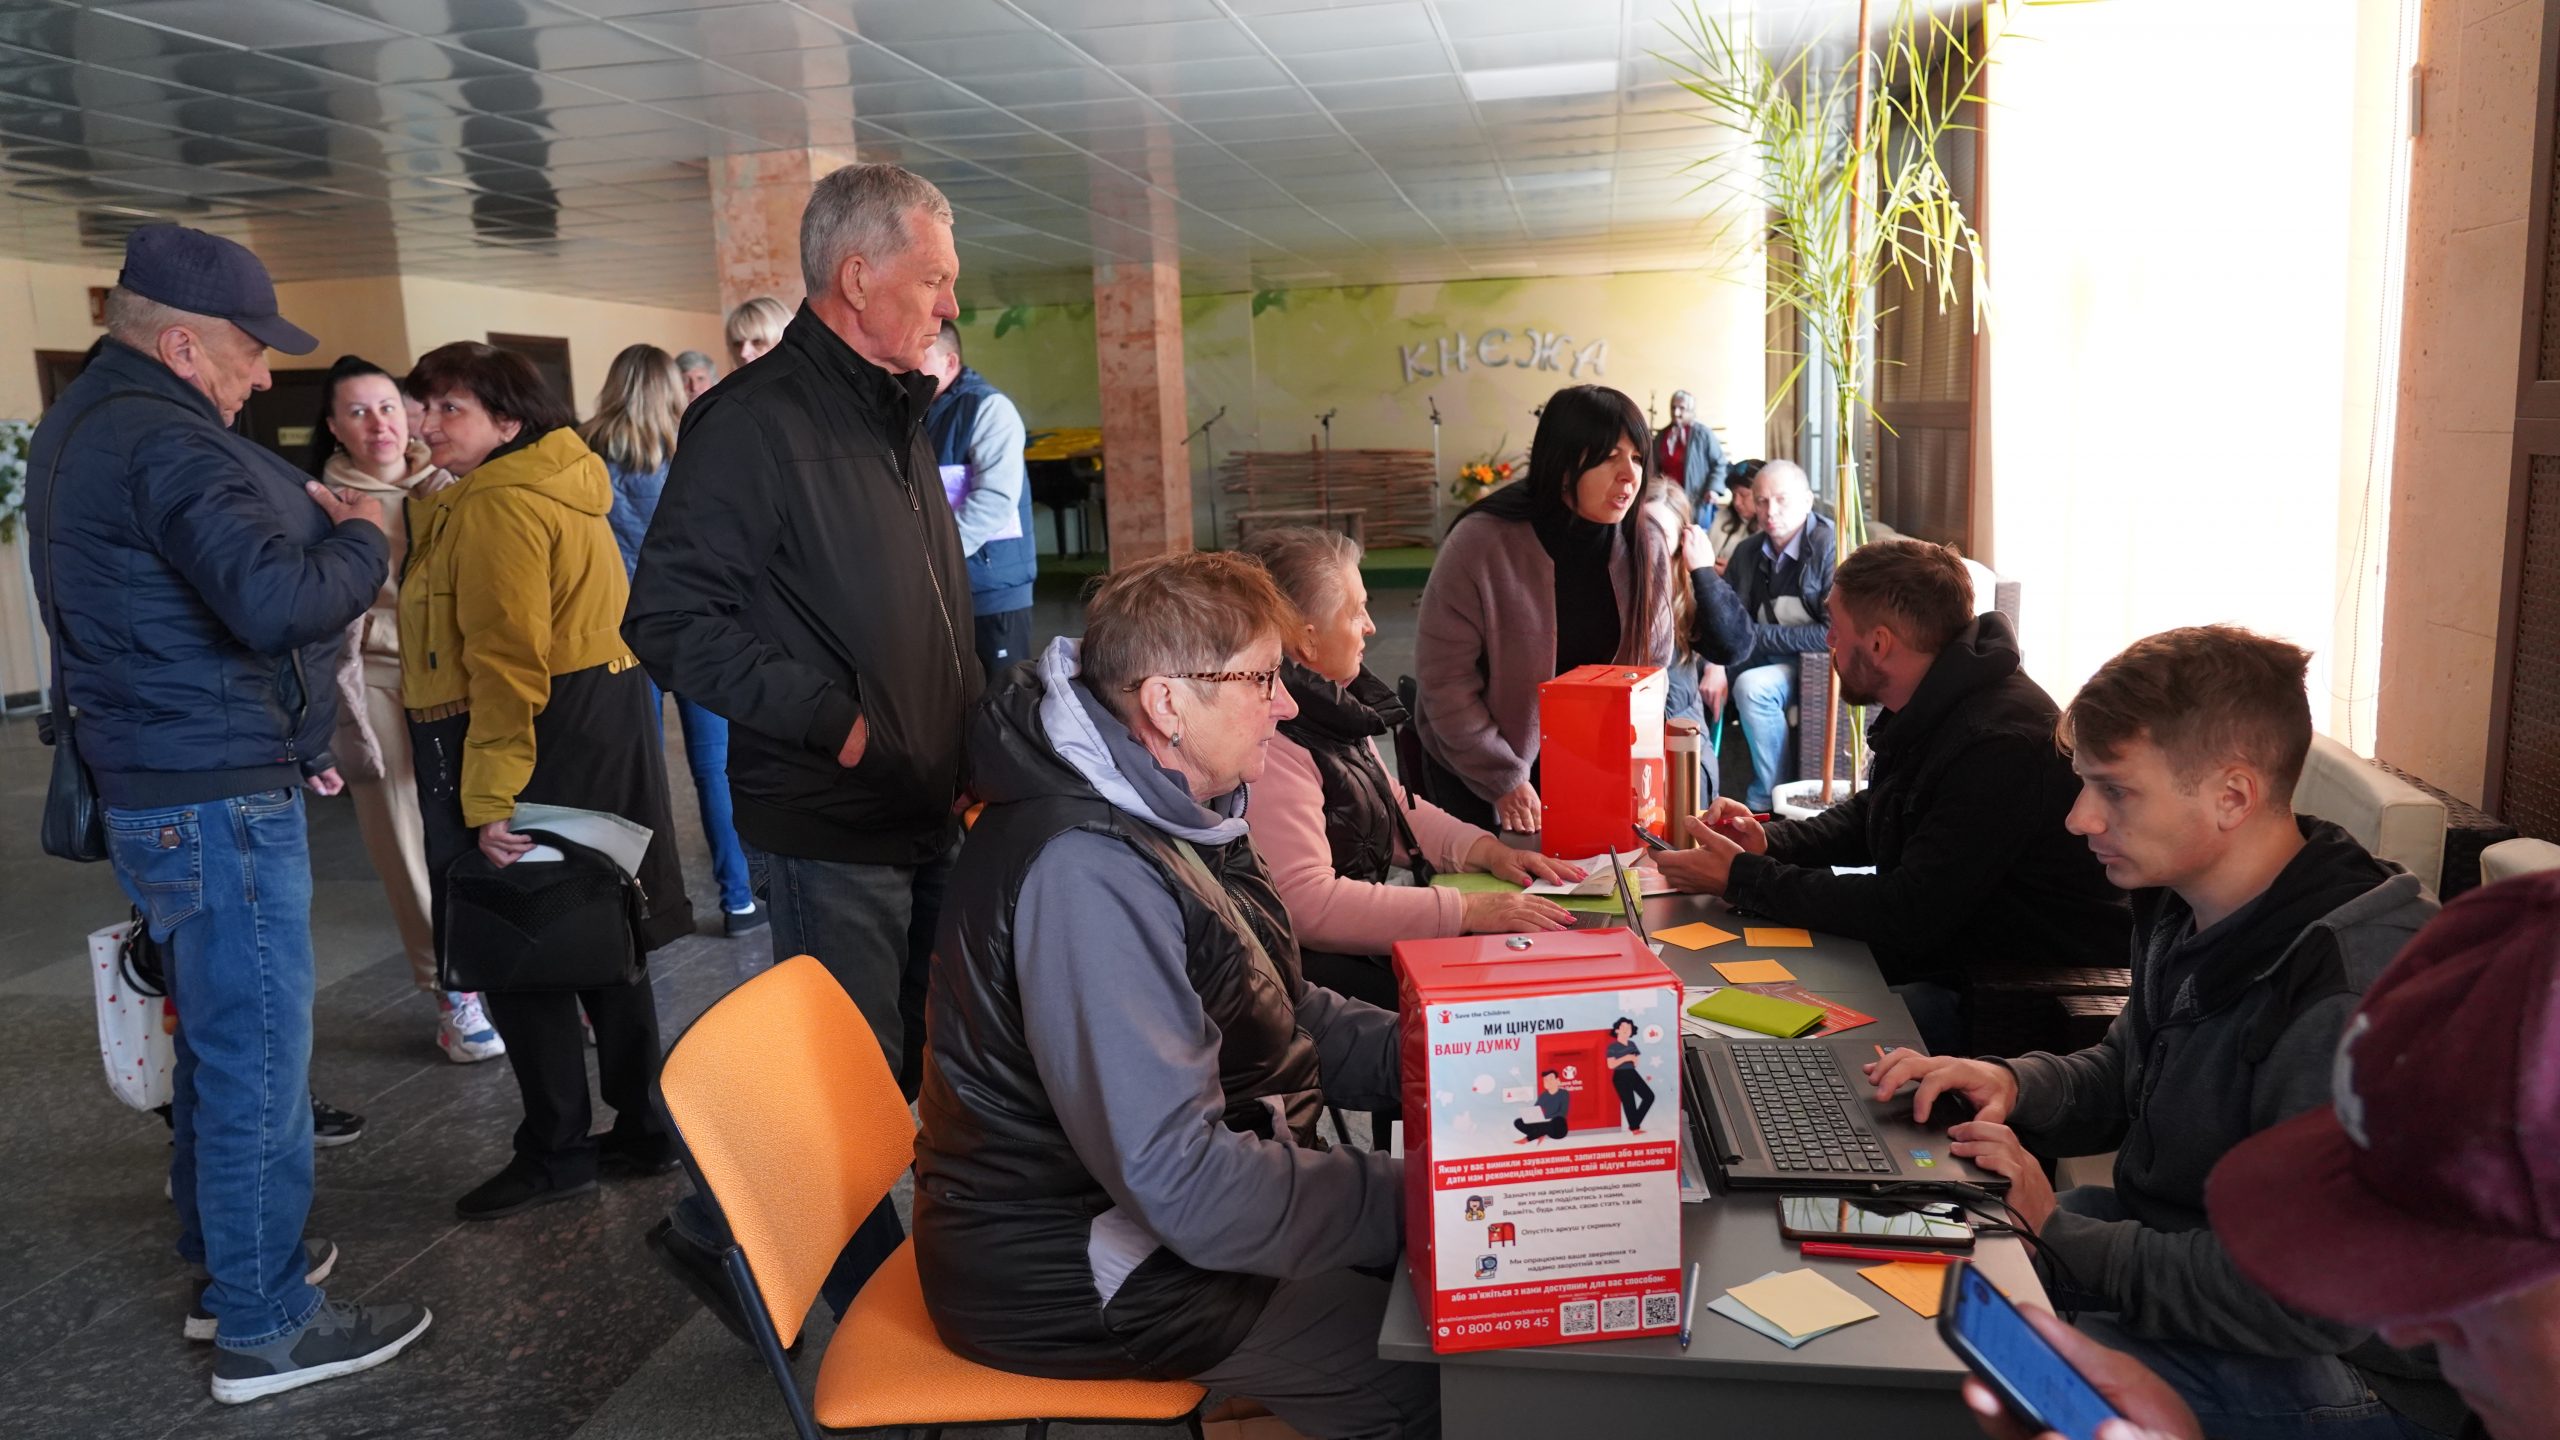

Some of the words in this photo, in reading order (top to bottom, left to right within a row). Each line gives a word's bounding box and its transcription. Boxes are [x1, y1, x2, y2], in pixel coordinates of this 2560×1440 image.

[1483, 1009, 1511, 1017] Children
[1483, 1023, 1502, 1036] МИ
[1506, 1017, 1564, 1035] ЦІНУЄМО
[1434, 1041, 1472, 1056] ВАШУ
[1475, 1037, 1521, 1055] ДУМКУ
[1438, 1164, 1462, 1174] Якщо
[1463, 1164, 1470, 1173] у
[1470, 1163, 1484, 1171] вас
[1486, 1160, 1521, 1169] виникли
[1618, 1148, 1633, 1158] або
[1634, 1149, 1644, 1157] ви
[1645, 1147, 1673, 1155] хочете
[1446, 1175, 1466, 1185] дати
[1468, 1174, 1484, 1182] нам
[1485, 1167, 1543, 1182] рекомендацію
[1581, 1162, 1598, 1171] свій
[1599, 1160, 1626, 1170] відгук
[1521, 1227, 1554, 1236] Опустіть
[1555, 1225, 1580, 1233] аркуш
[1451, 1292, 1466, 1302] або
[1513, 1288, 1519, 1296] з
[1520, 1287, 1542, 1295] нами
[1543, 1282, 1587, 1294] доступним
[1589, 1280, 1606, 1289] для
[1608, 1279, 1622, 1287] вас
[1456, 1324, 1465, 1335] 0
[1468, 1322, 1492, 1334] 800
[1495, 1320, 1512, 1331] 40
[1514, 1318, 1530, 1329] 98
[1533, 1316, 1549, 1327] 45
